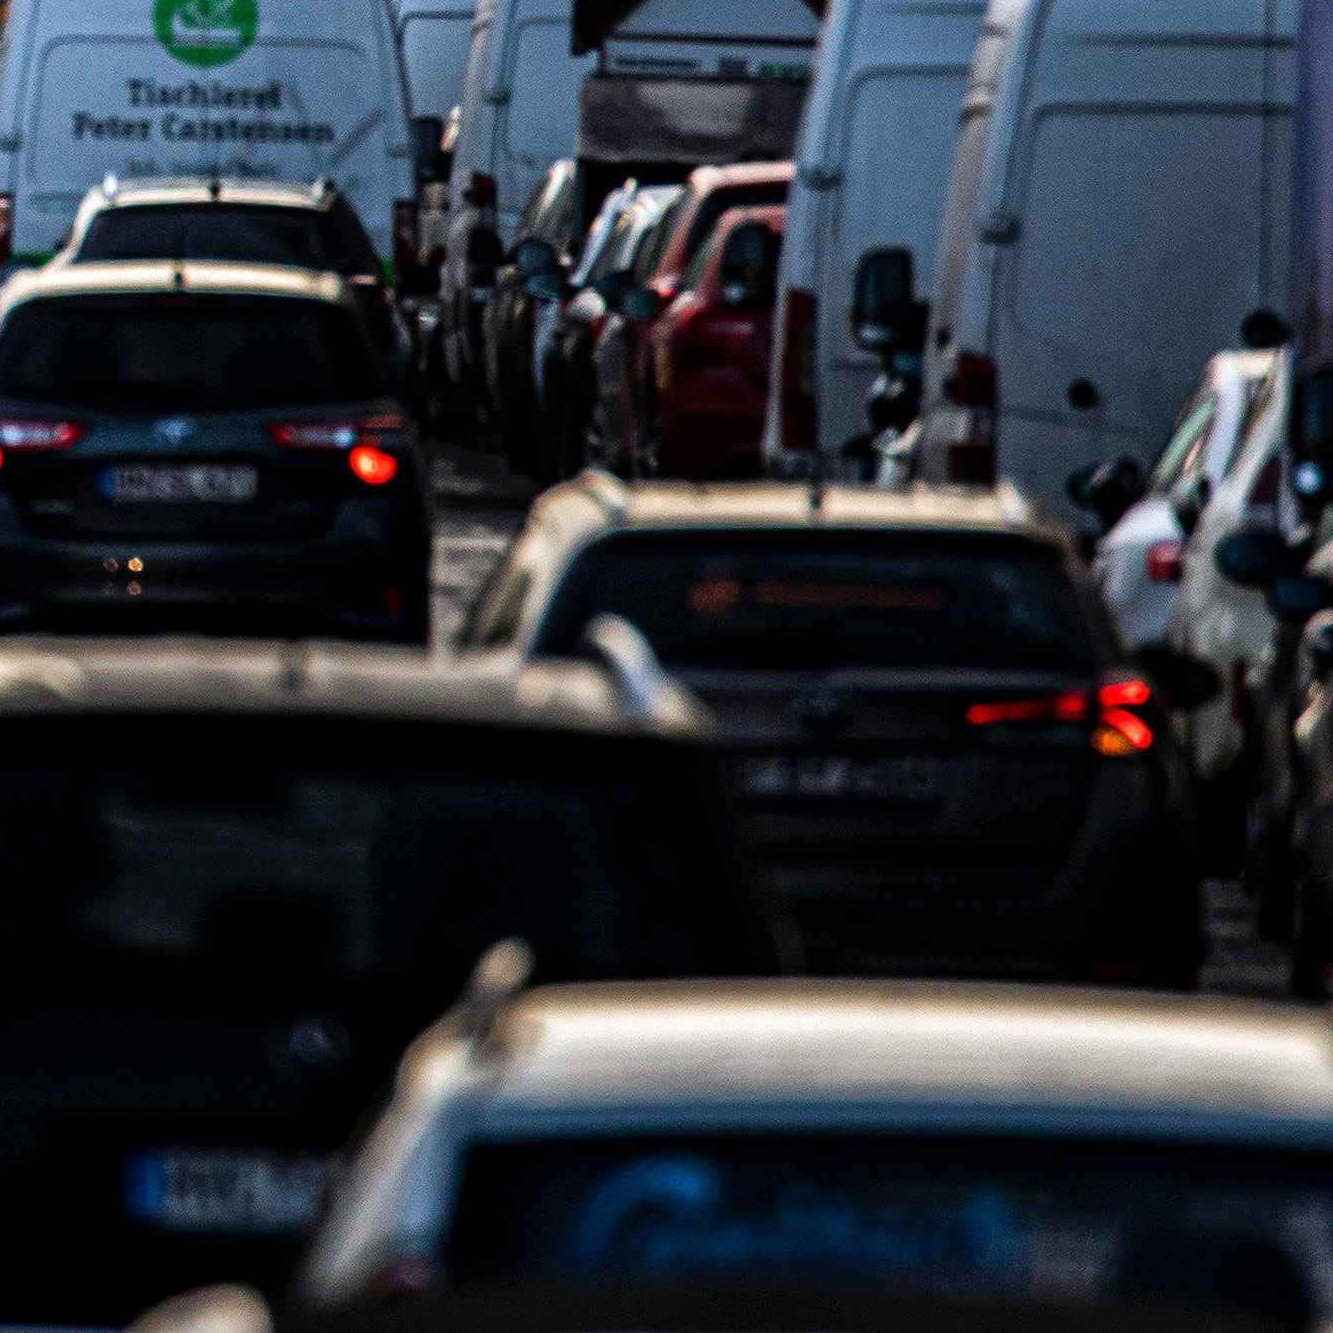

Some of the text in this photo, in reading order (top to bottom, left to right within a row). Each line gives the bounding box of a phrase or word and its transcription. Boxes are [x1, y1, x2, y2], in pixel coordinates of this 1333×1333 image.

[128, 78, 281, 107] Tischlerei
[72, 110, 335, 144] Peter Carstensen
